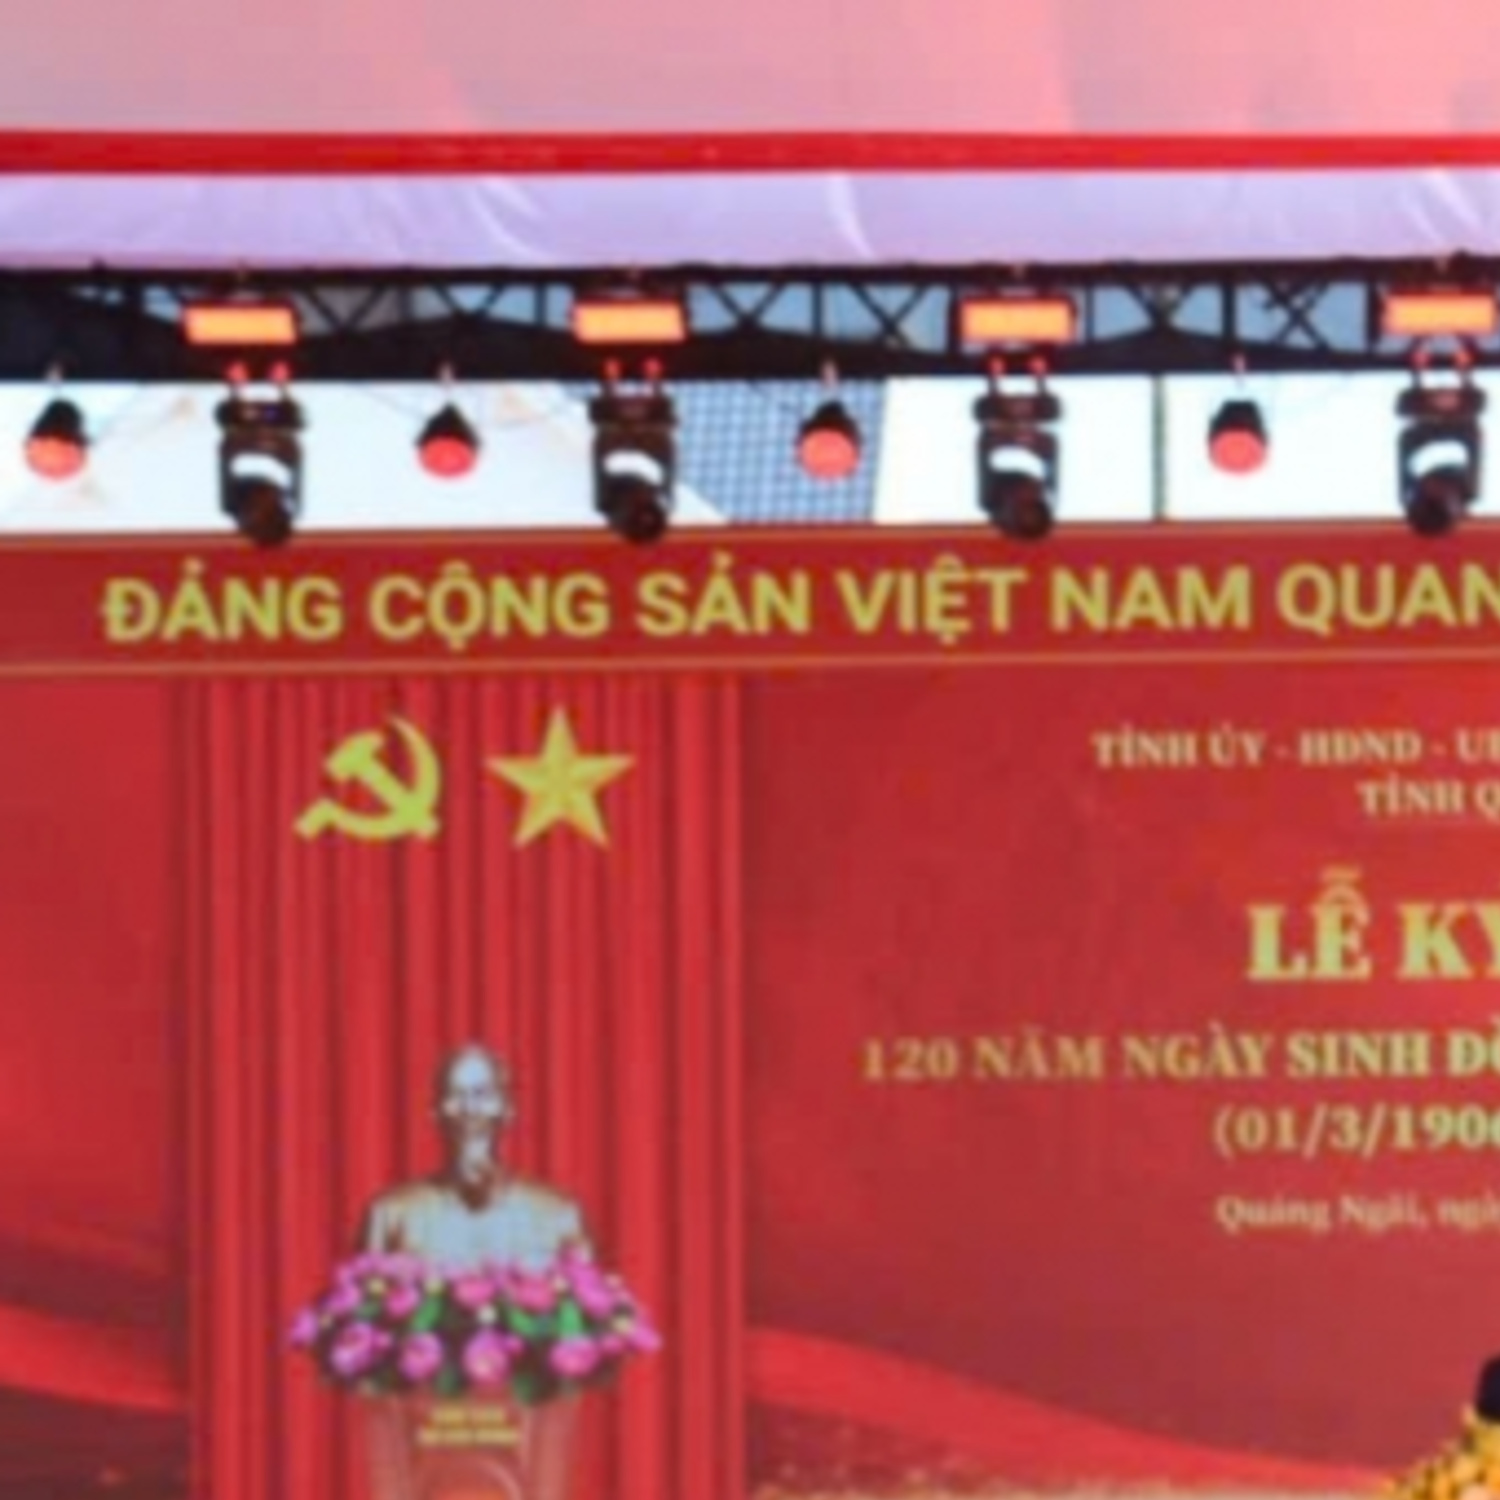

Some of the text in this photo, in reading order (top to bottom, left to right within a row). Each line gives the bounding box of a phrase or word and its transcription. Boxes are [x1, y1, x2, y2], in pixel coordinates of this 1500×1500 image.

[102, 556, 344, 643] ĐẢNG
[369, 562, 611, 652] CỘNG
[636, 552, 810, 637] SẢN
[837, 554, 1027, 645] VIỆT
[1052, 563, 1251, 632] NAM
[1247, 867, 1372, 981] LỄ
[863, 1036, 959, 1081] 120
[1122, 1019, 1273, 1080] NGÀY
[1286, 1030, 1431, 1078] SINH
